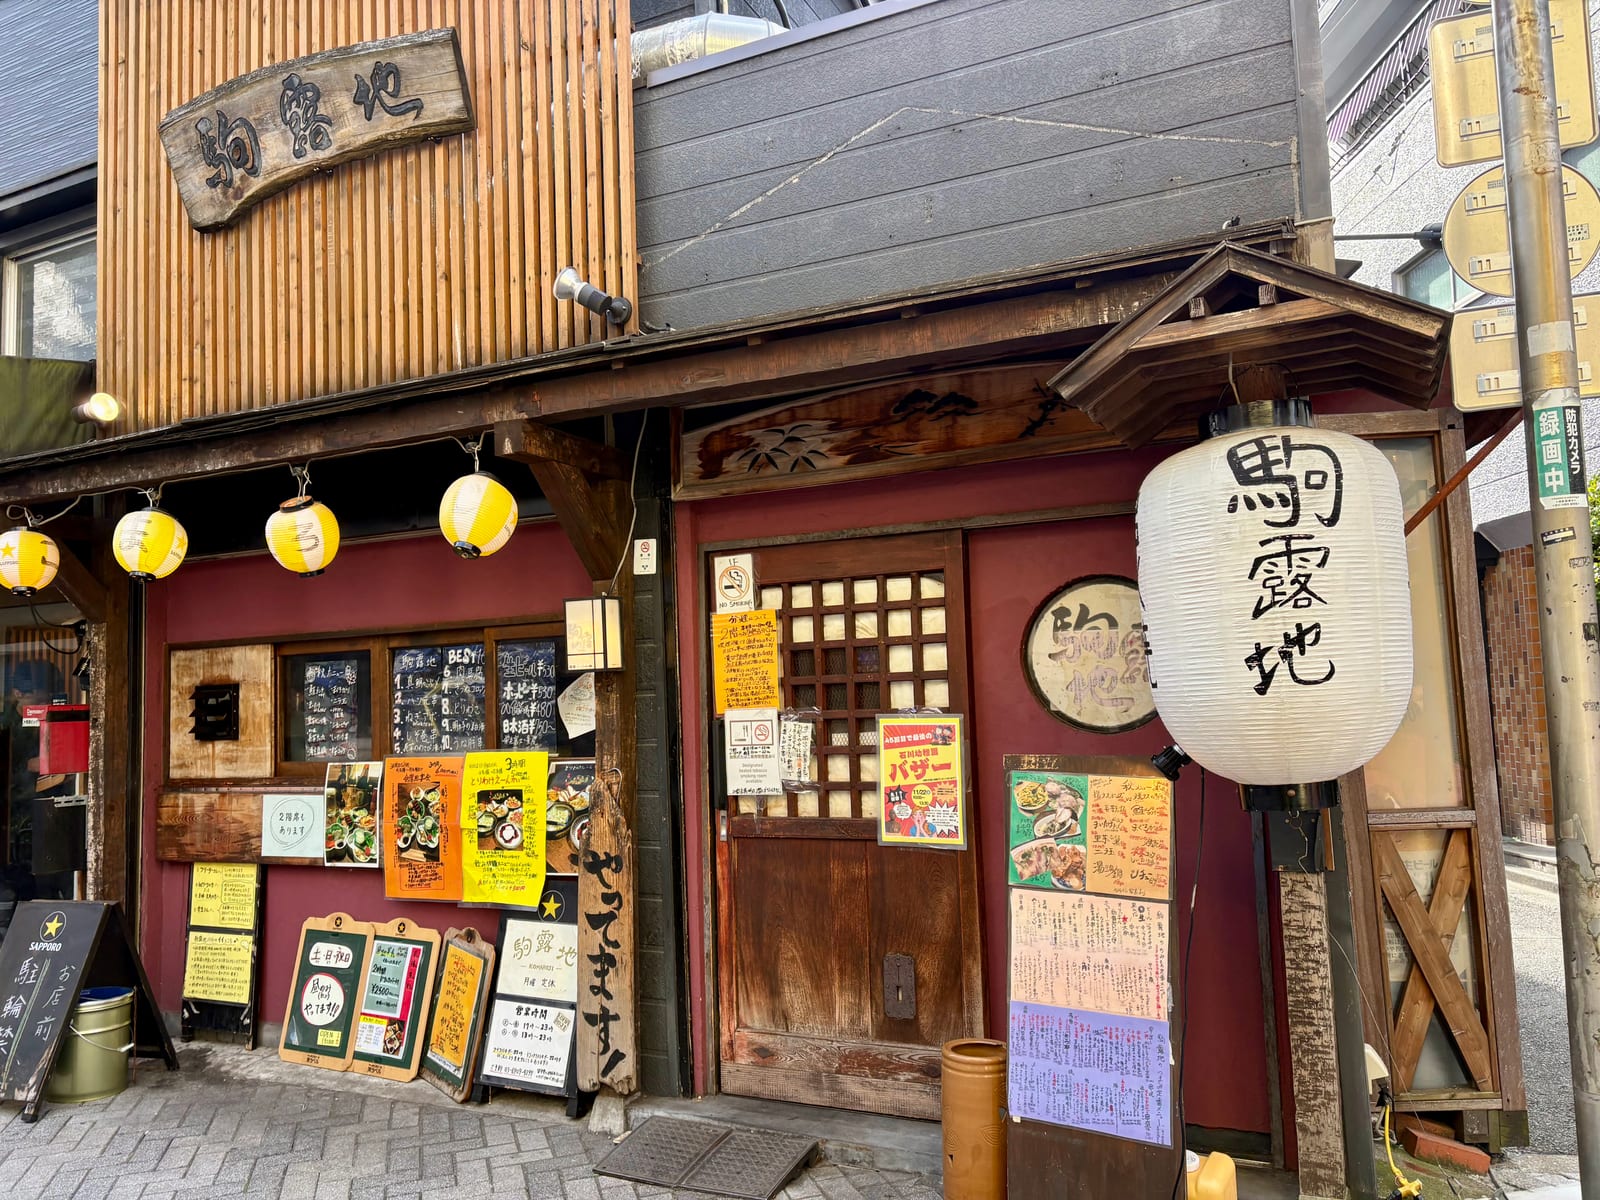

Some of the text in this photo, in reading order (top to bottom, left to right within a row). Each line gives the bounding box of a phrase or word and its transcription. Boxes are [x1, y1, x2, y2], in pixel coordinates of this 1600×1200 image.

[195, 61, 424, 188] 駒露地
[1565, 408, 1581, 475] 防犯カメラ
[1538, 411, 1565, 494] 録画中
[1227, 434, 1344, 696] 駒露地
[899, 747, 939, 759] 石川幼稚園
[889, 758, 951, 783] バザー
[279, 812, 304, 822] 2階席も
[280, 826, 305, 836] あります
[28, 941, 63, 952] SAPPORO
[513, 929, 577, 967] 駒露地
[310, 978, 332, 993] 昼のみ
[541, 977, 556, 988] 定休
[515, 1005, 548, 1020] 営業時間
